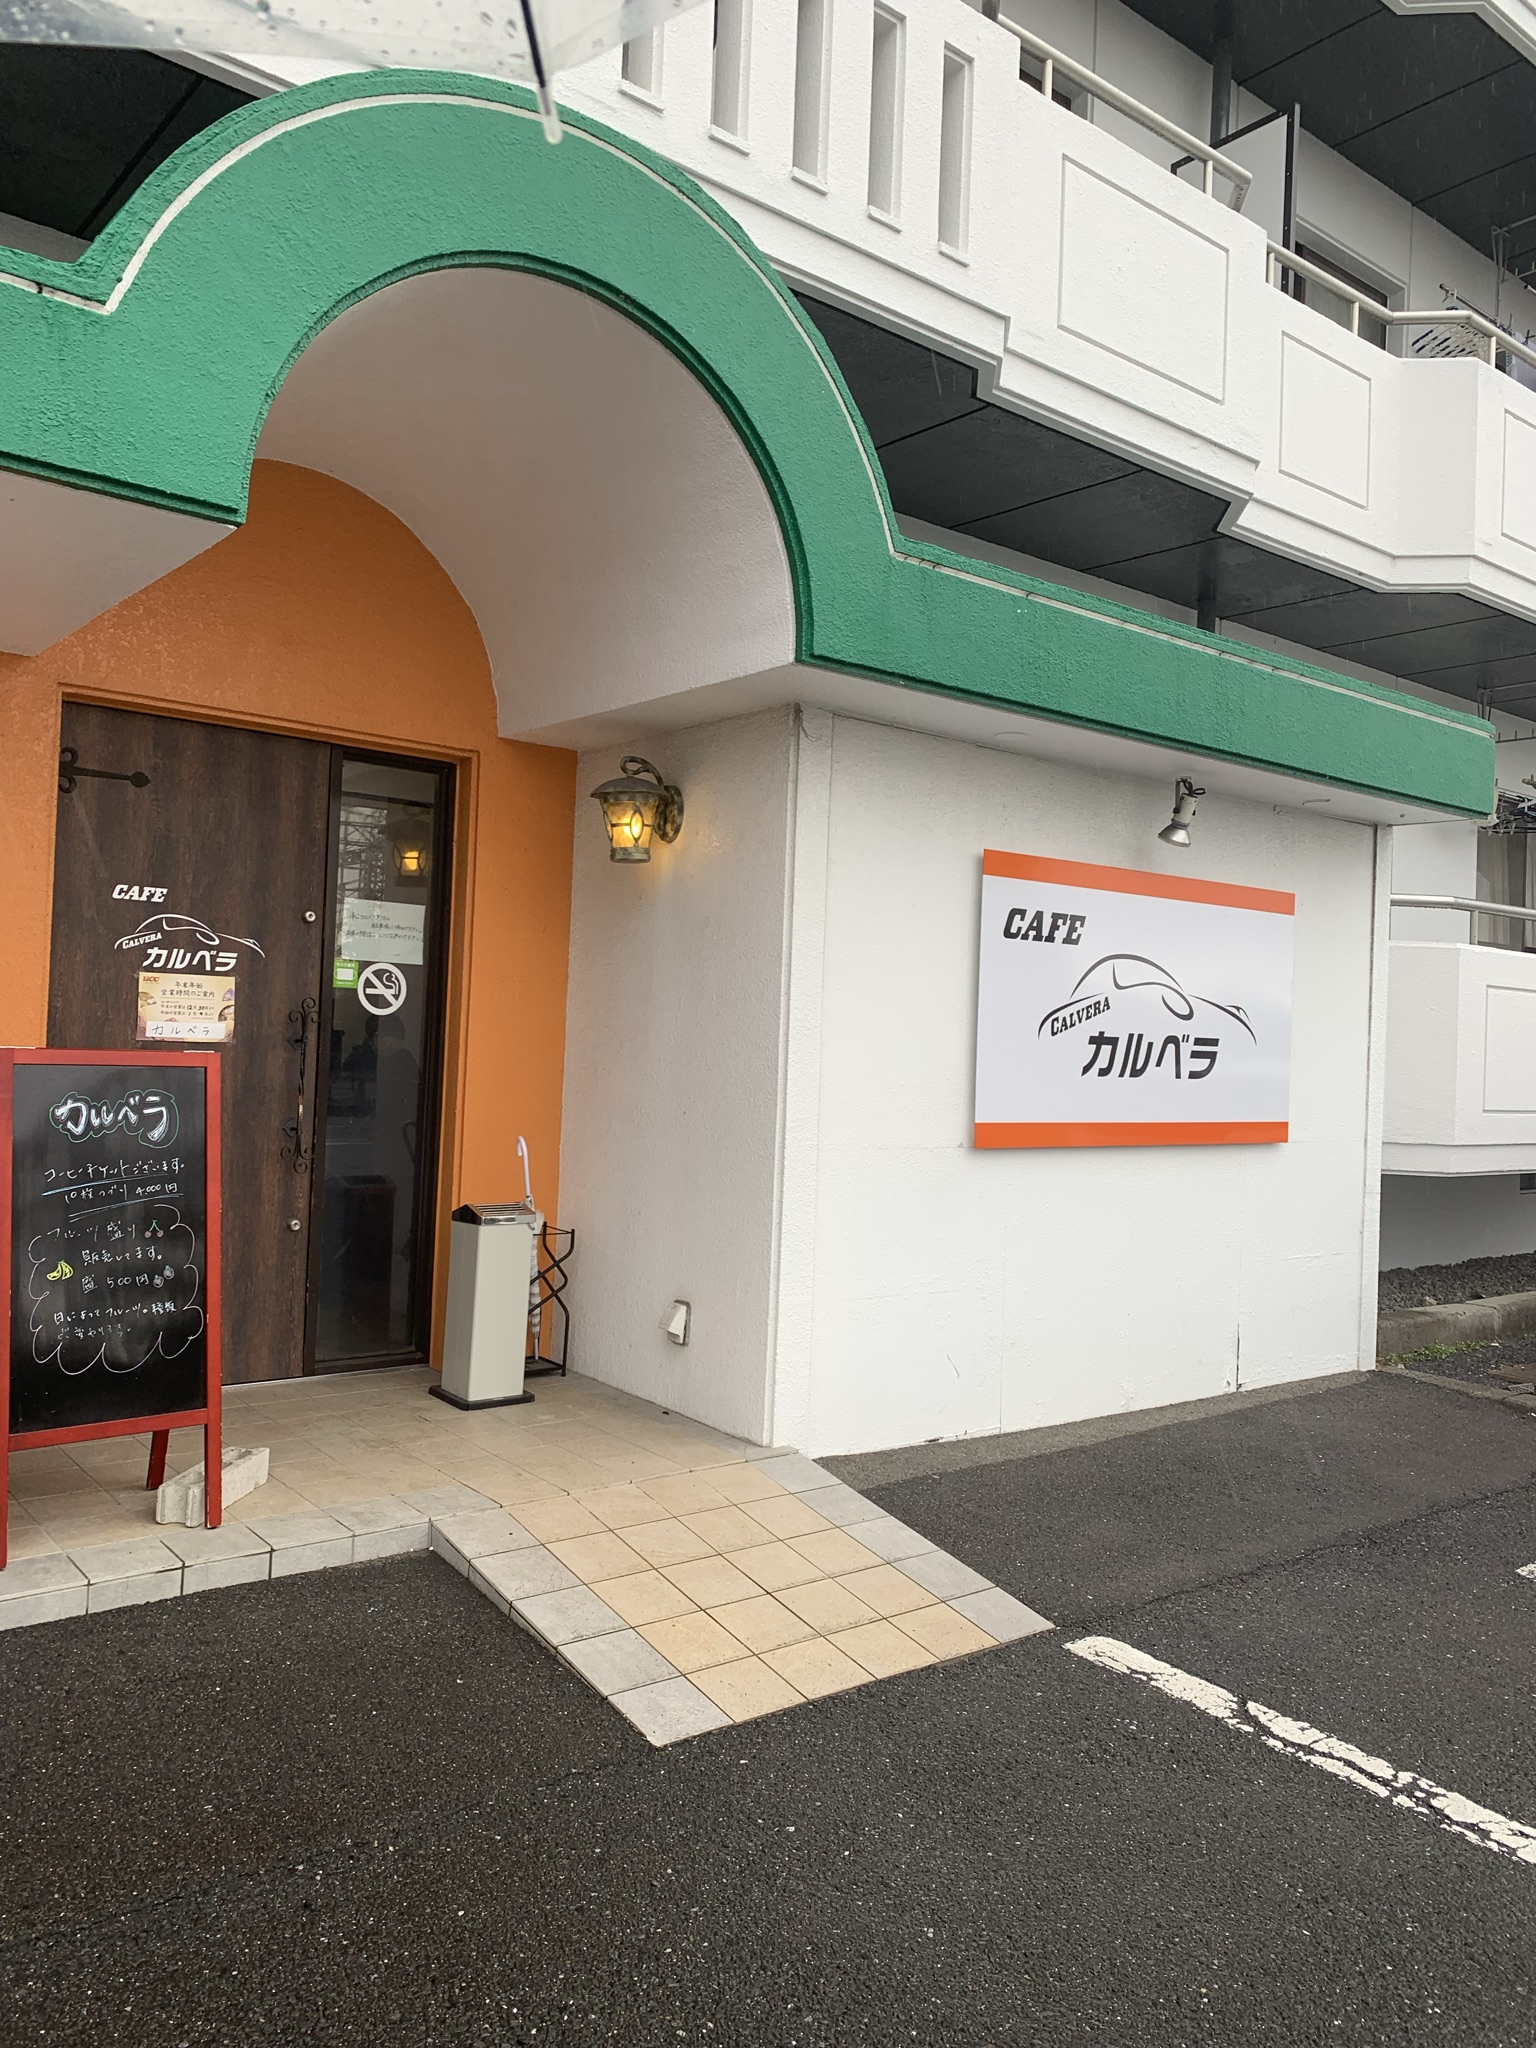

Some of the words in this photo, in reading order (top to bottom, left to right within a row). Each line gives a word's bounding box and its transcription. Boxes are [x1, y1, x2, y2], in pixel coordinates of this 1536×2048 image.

[112, 884, 168, 903] CAFE
[1003, 907, 1087, 946] CAFE
[122, 932, 162, 950] CALVERA
[142, 947, 238, 972] カルベラ
[160, 988, 215, 998] 営業時間のご案内
[174, 981, 203, 989] 年末年始
[1050, 996, 1110, 1037] CALVERA
[152, 1025, 210, 1036] カルベラ
[1081, 1031, 1220, 1079] カルベラ
[54, 1095, 169, 1142] カルベラ
